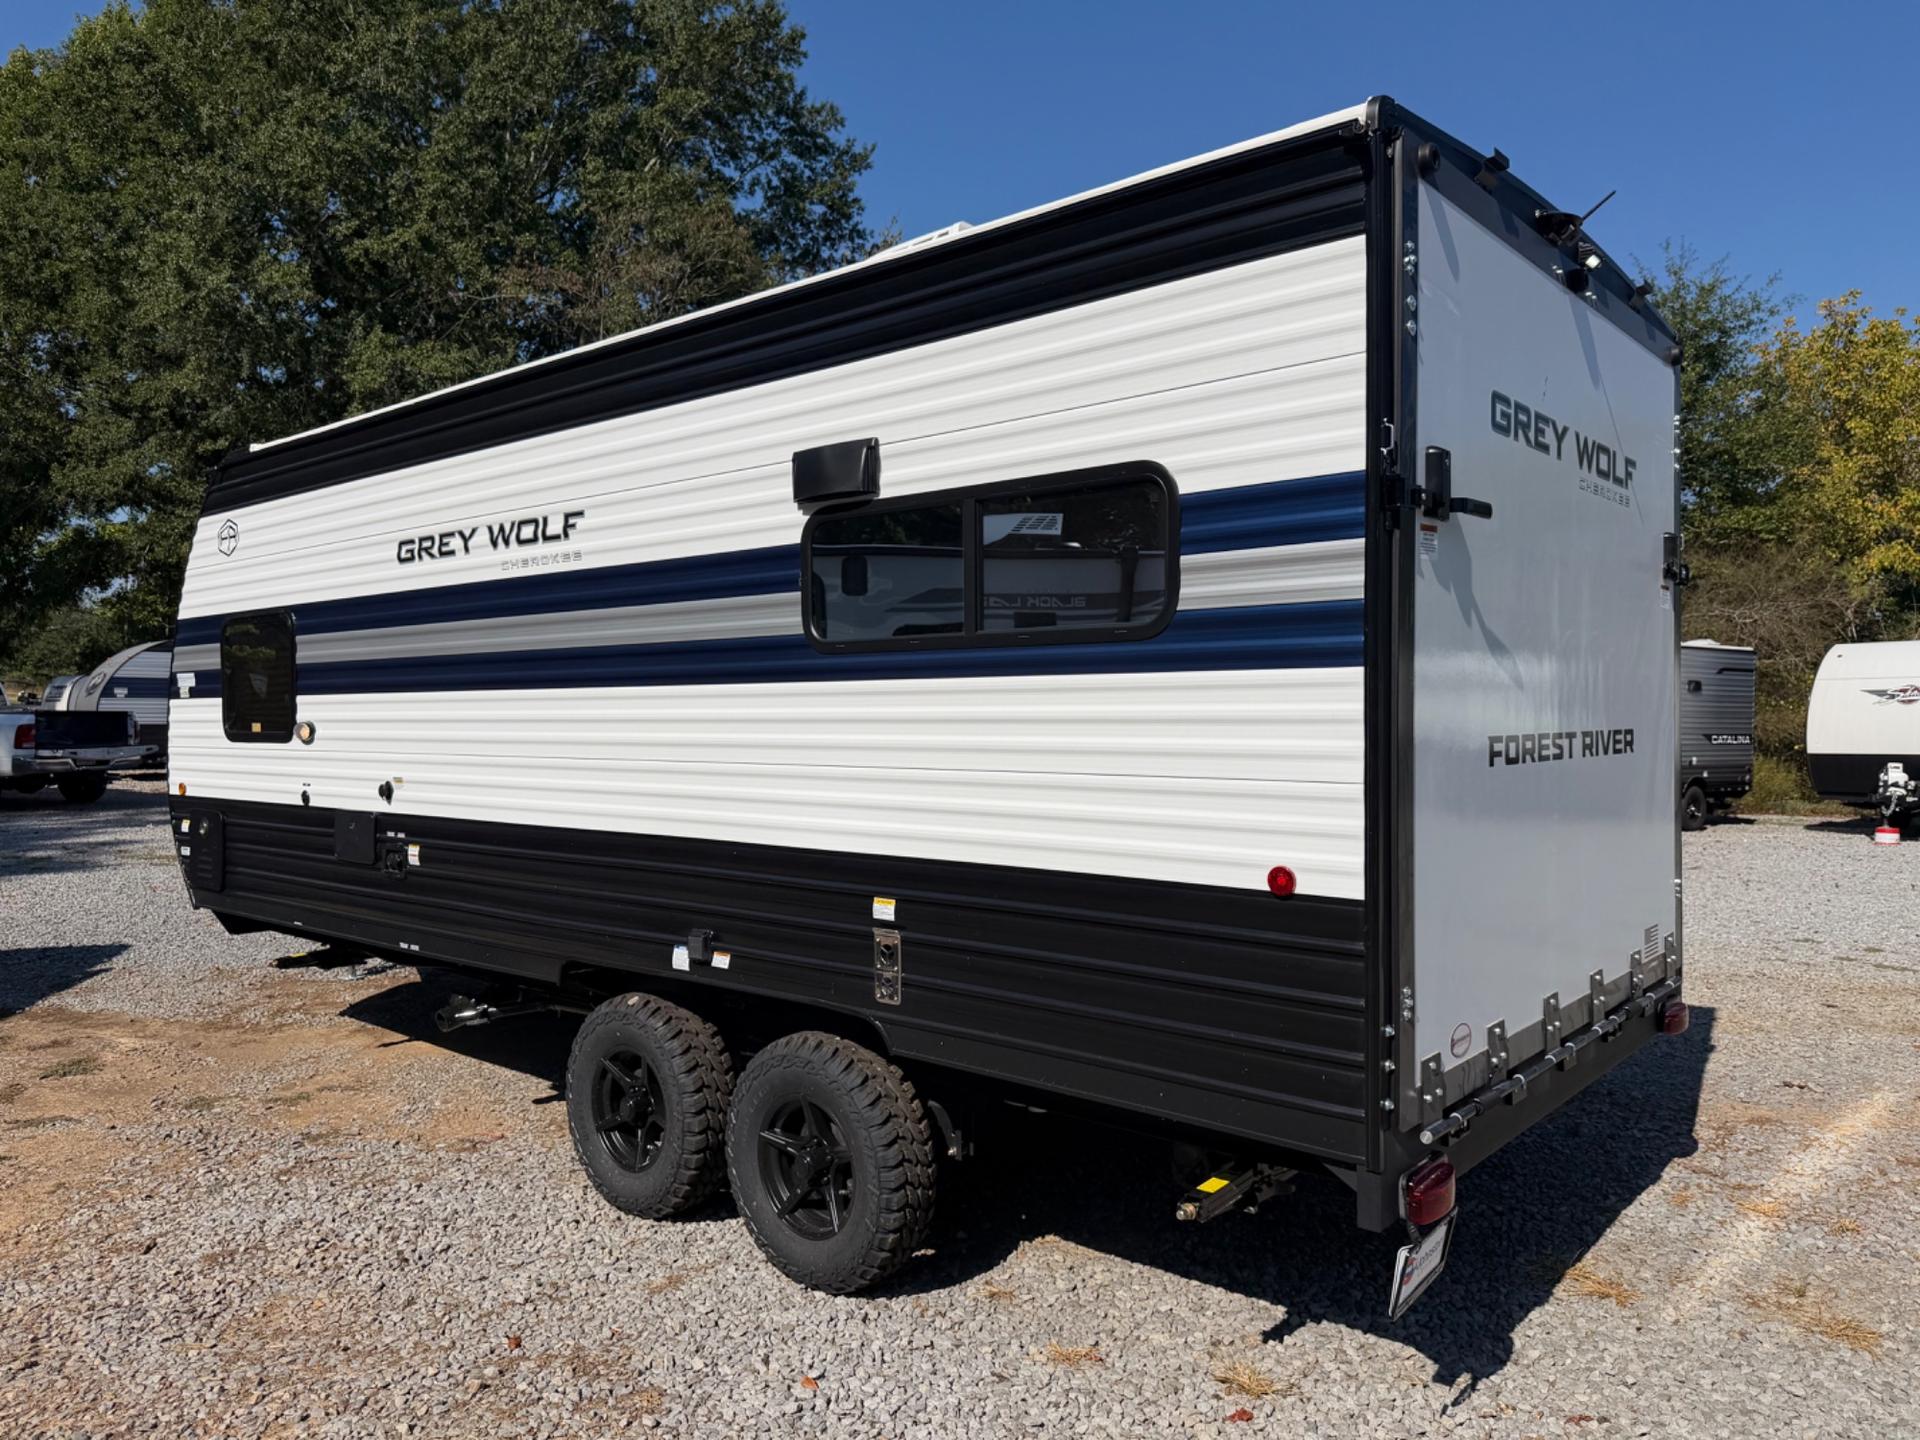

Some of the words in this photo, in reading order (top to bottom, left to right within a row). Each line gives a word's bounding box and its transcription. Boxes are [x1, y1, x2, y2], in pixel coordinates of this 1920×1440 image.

[1491, 389, 1569, 462] GREY
[1575, 430, 1637, 490] WOLF
[397, 527, 479, 564] GREY
[487, 510, 586, 550] WOLF
[501, 550, 582, 572] CHEROKEE
[1487, 731, 1577, 768] FOREST
[1581, 728, 1635, 758] RIVER
[1711, 735, 1751, 745] CATALINA
